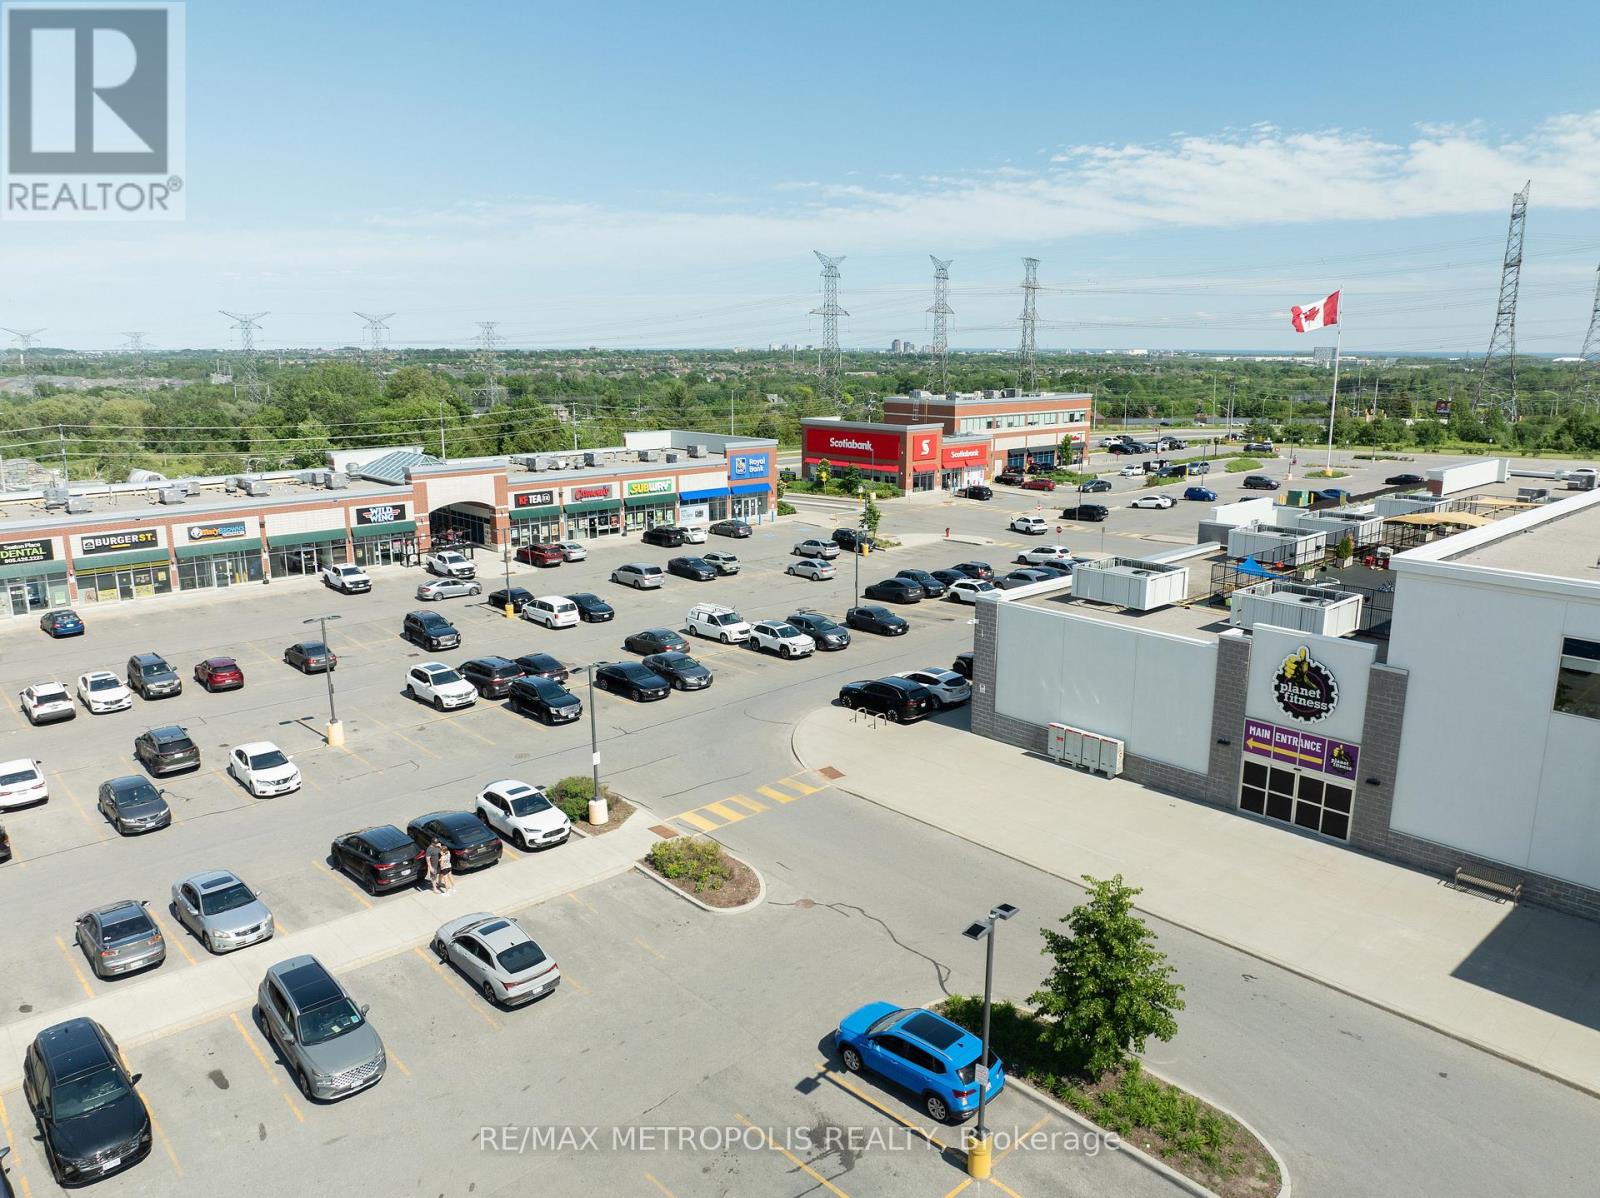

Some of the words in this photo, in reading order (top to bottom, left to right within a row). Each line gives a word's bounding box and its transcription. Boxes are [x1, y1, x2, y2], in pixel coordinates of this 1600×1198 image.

[829, 437, 873, 450] Scotiabank
[951, 449, 979, 458] Scotiabank
[749, 457, 766, 467] Royal
[749, 465, 764, 473] Bank
[630, 482, 672, 495] SUBWAY
[529, 494, 542, 504] TEA
[369, 506, 393, 515] WILD
[370, 513, 395, 522] WING
[0, 547, 47, 559] DENTAL
[1280, 682, 1321, 699] planet
[1283, 692, 1328, 711] fitness
[1249, 726, 1271, 740] MAIN
[1275, 732, 1322, 753] ENTRANCE
